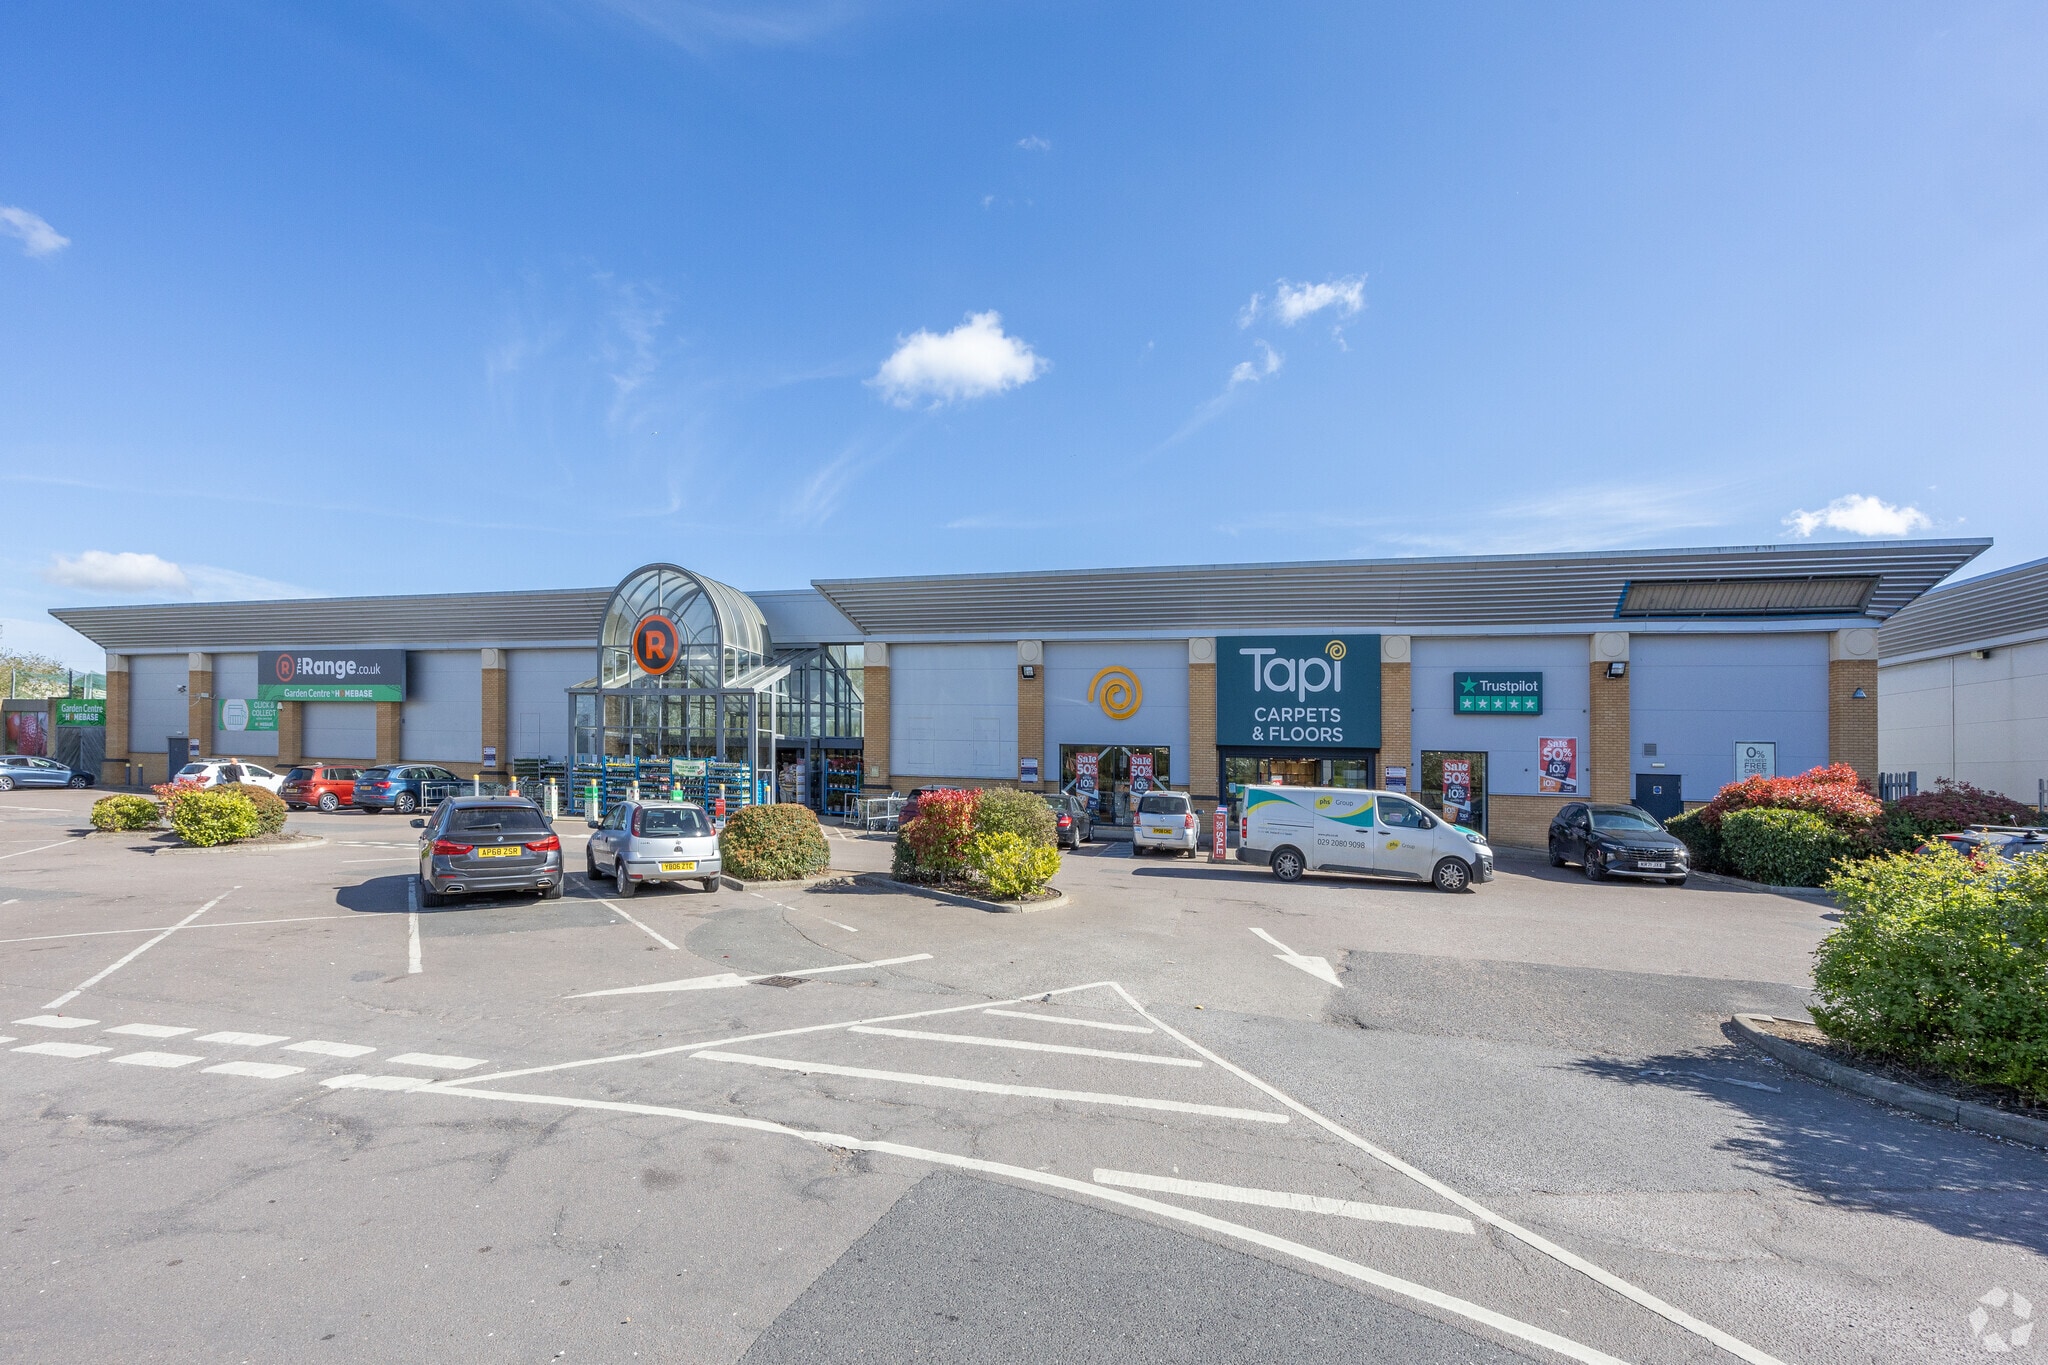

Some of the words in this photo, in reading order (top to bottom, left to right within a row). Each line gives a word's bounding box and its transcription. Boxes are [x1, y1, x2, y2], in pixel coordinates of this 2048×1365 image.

[645, 630, 666, 660] R
[1239, 640, 1347, 703] Tapi
[1479, 680, 1538, 694] Trustpilot
[284, 688, 308, 698] Garden
[308, 688, 331, 698] Centre
[61, 703, 82, 713] Garden
[83, 703, 104, 713] Centre
[253, 701, 269, 709] CLICK
[251, 709, 276, 717] COLLECT
[1254, 707, 1341, 723] CARPETS
[1252, 726, 1264, 741] &
[1269, 726, 1344, 742] FLOORS
[1547, 740, 1568, 748] Sale
[1543, 747, 1573, 761] 50%
[1746, 746, 1766, 759] 0%
[1077, 754, 1097, 763] Sale
[1131, 756, 1152, 765] Sale
[1077, 763, 1098, 775] 50%
[1131, 765, 1153, 777] 50%
[1445, 762, 1469, 771] Sale
[1549, 764, 1567, 773] 10%
[1744, 762, 1767, 770] FREE
[1444, 772, 1470, 784] 50%
[1080, 779, 1095, 788] 10%
[1134, 780, 1149, 790] 10%
[1448, 789, 1465, 799] 10%
[1319, 798, 1331, 806] phs
[1335, 799, 1354, 807] Group
[1216, 831, 1224, 855] SALE
[1317, 838, 1330, 846] 029
[1330, 839, 1348, 848] 2080
[1348, 840, 1366, 849] 9098
